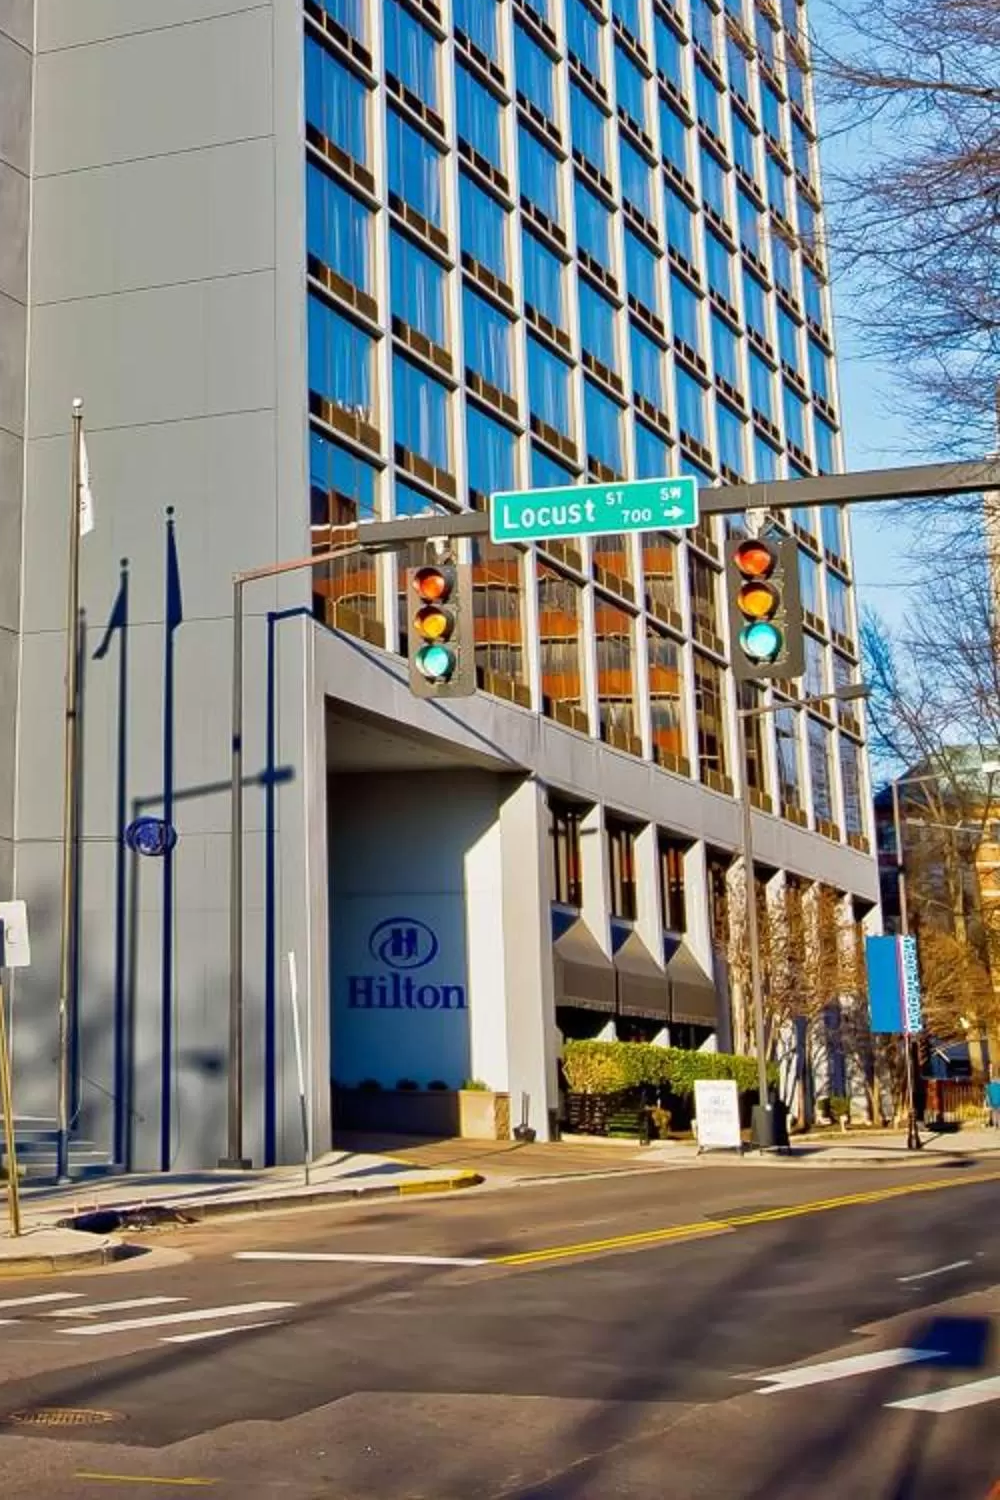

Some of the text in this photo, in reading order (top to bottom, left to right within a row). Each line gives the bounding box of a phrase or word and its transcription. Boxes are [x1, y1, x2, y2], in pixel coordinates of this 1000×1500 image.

[503, 487, 682, 529] Locust ST SW
[621, 510, 651, 523] 700
[346, 971, 470, 1010] Hilton
